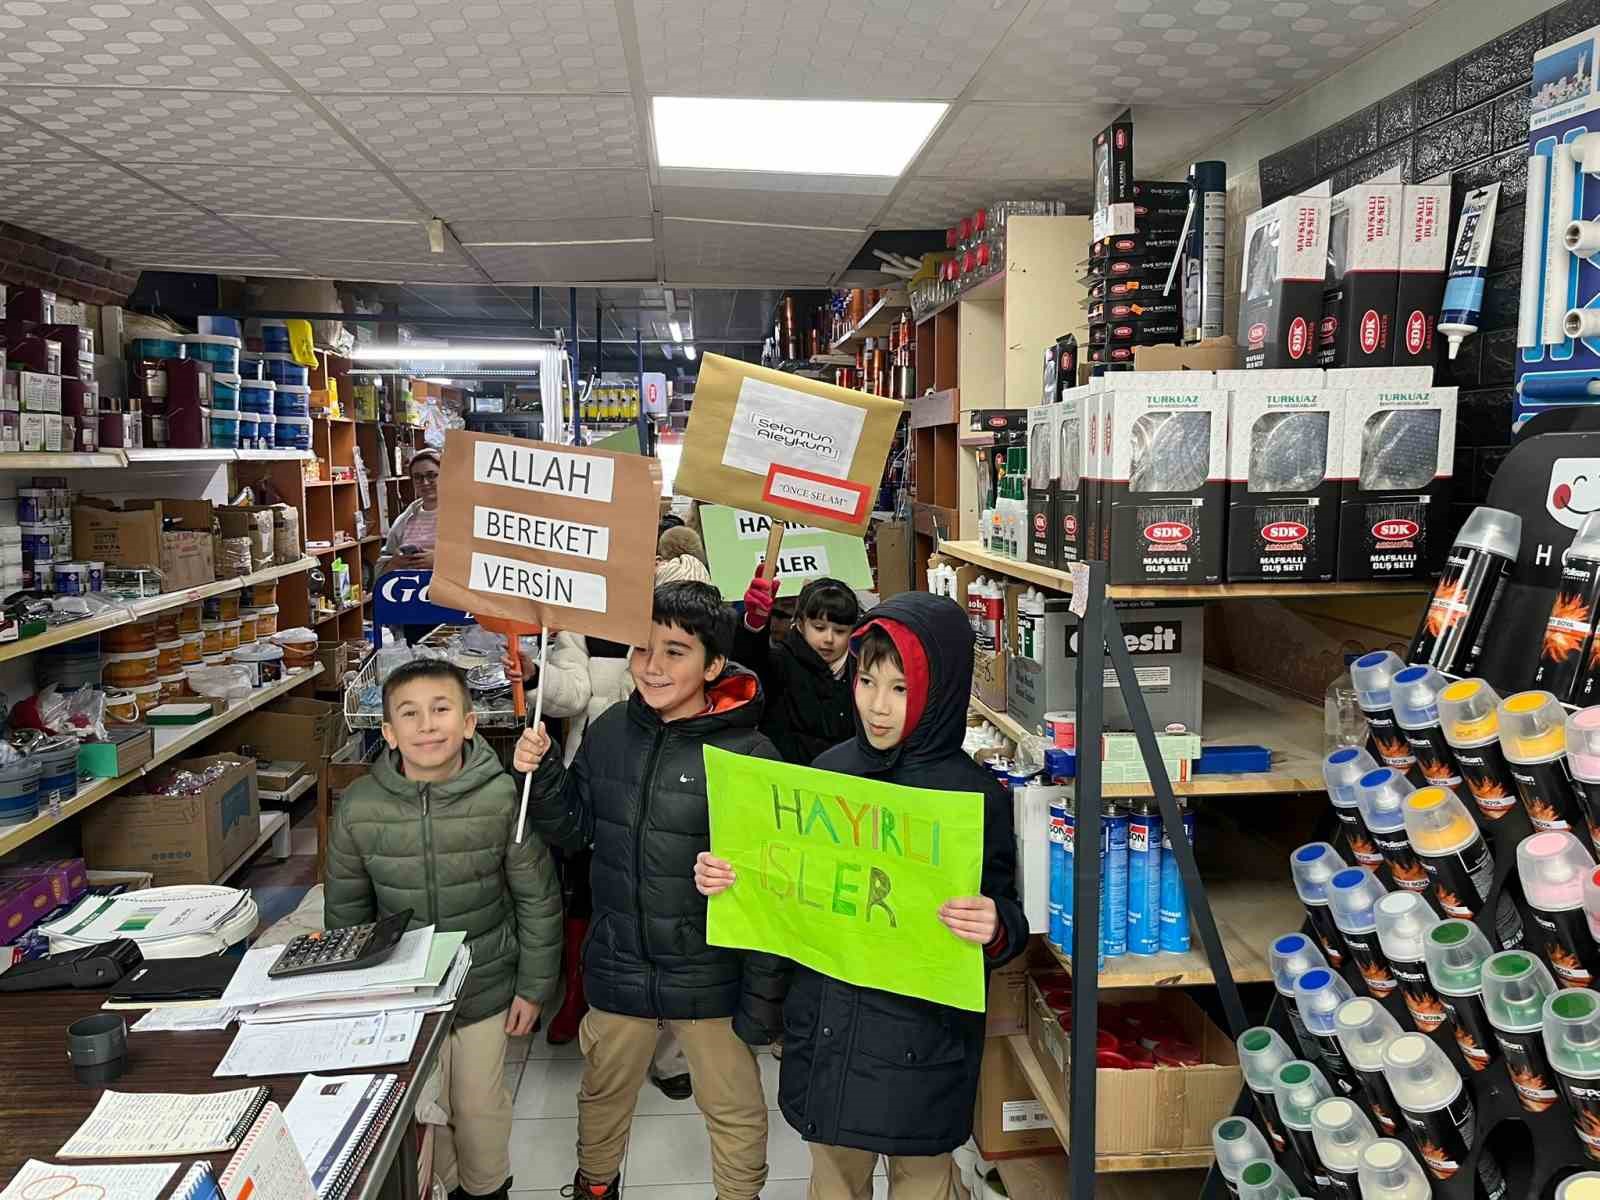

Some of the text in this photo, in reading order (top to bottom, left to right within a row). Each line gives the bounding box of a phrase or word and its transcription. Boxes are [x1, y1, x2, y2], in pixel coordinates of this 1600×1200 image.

[1292, 325, 1302, 351] SDK
[1365, 319, 1375, 345] SDK
[1411, 319, 1421, 346] SDK
[757, 418, 832, 444] Selamun
[757, 429, 832, 455] Aleykum
[487, 447, 592, 495] ALLAH
[487, 511, 600, 556] BEREKET
[1153, 527, 1183, 538] SDK
[1270, 527, 1298, 537] SDK
[1380, 524, 1410, 534] SDK
[1143, 557, 1191, 565] MAFSALLI
[1260, 556, 1306, 564] MAFSALLI
[1370, 554, 1416, 562] MAFSALLI
[484, 562, 573, 603] VERSİN
[772, 783, 940, 866] HAYIRLI
